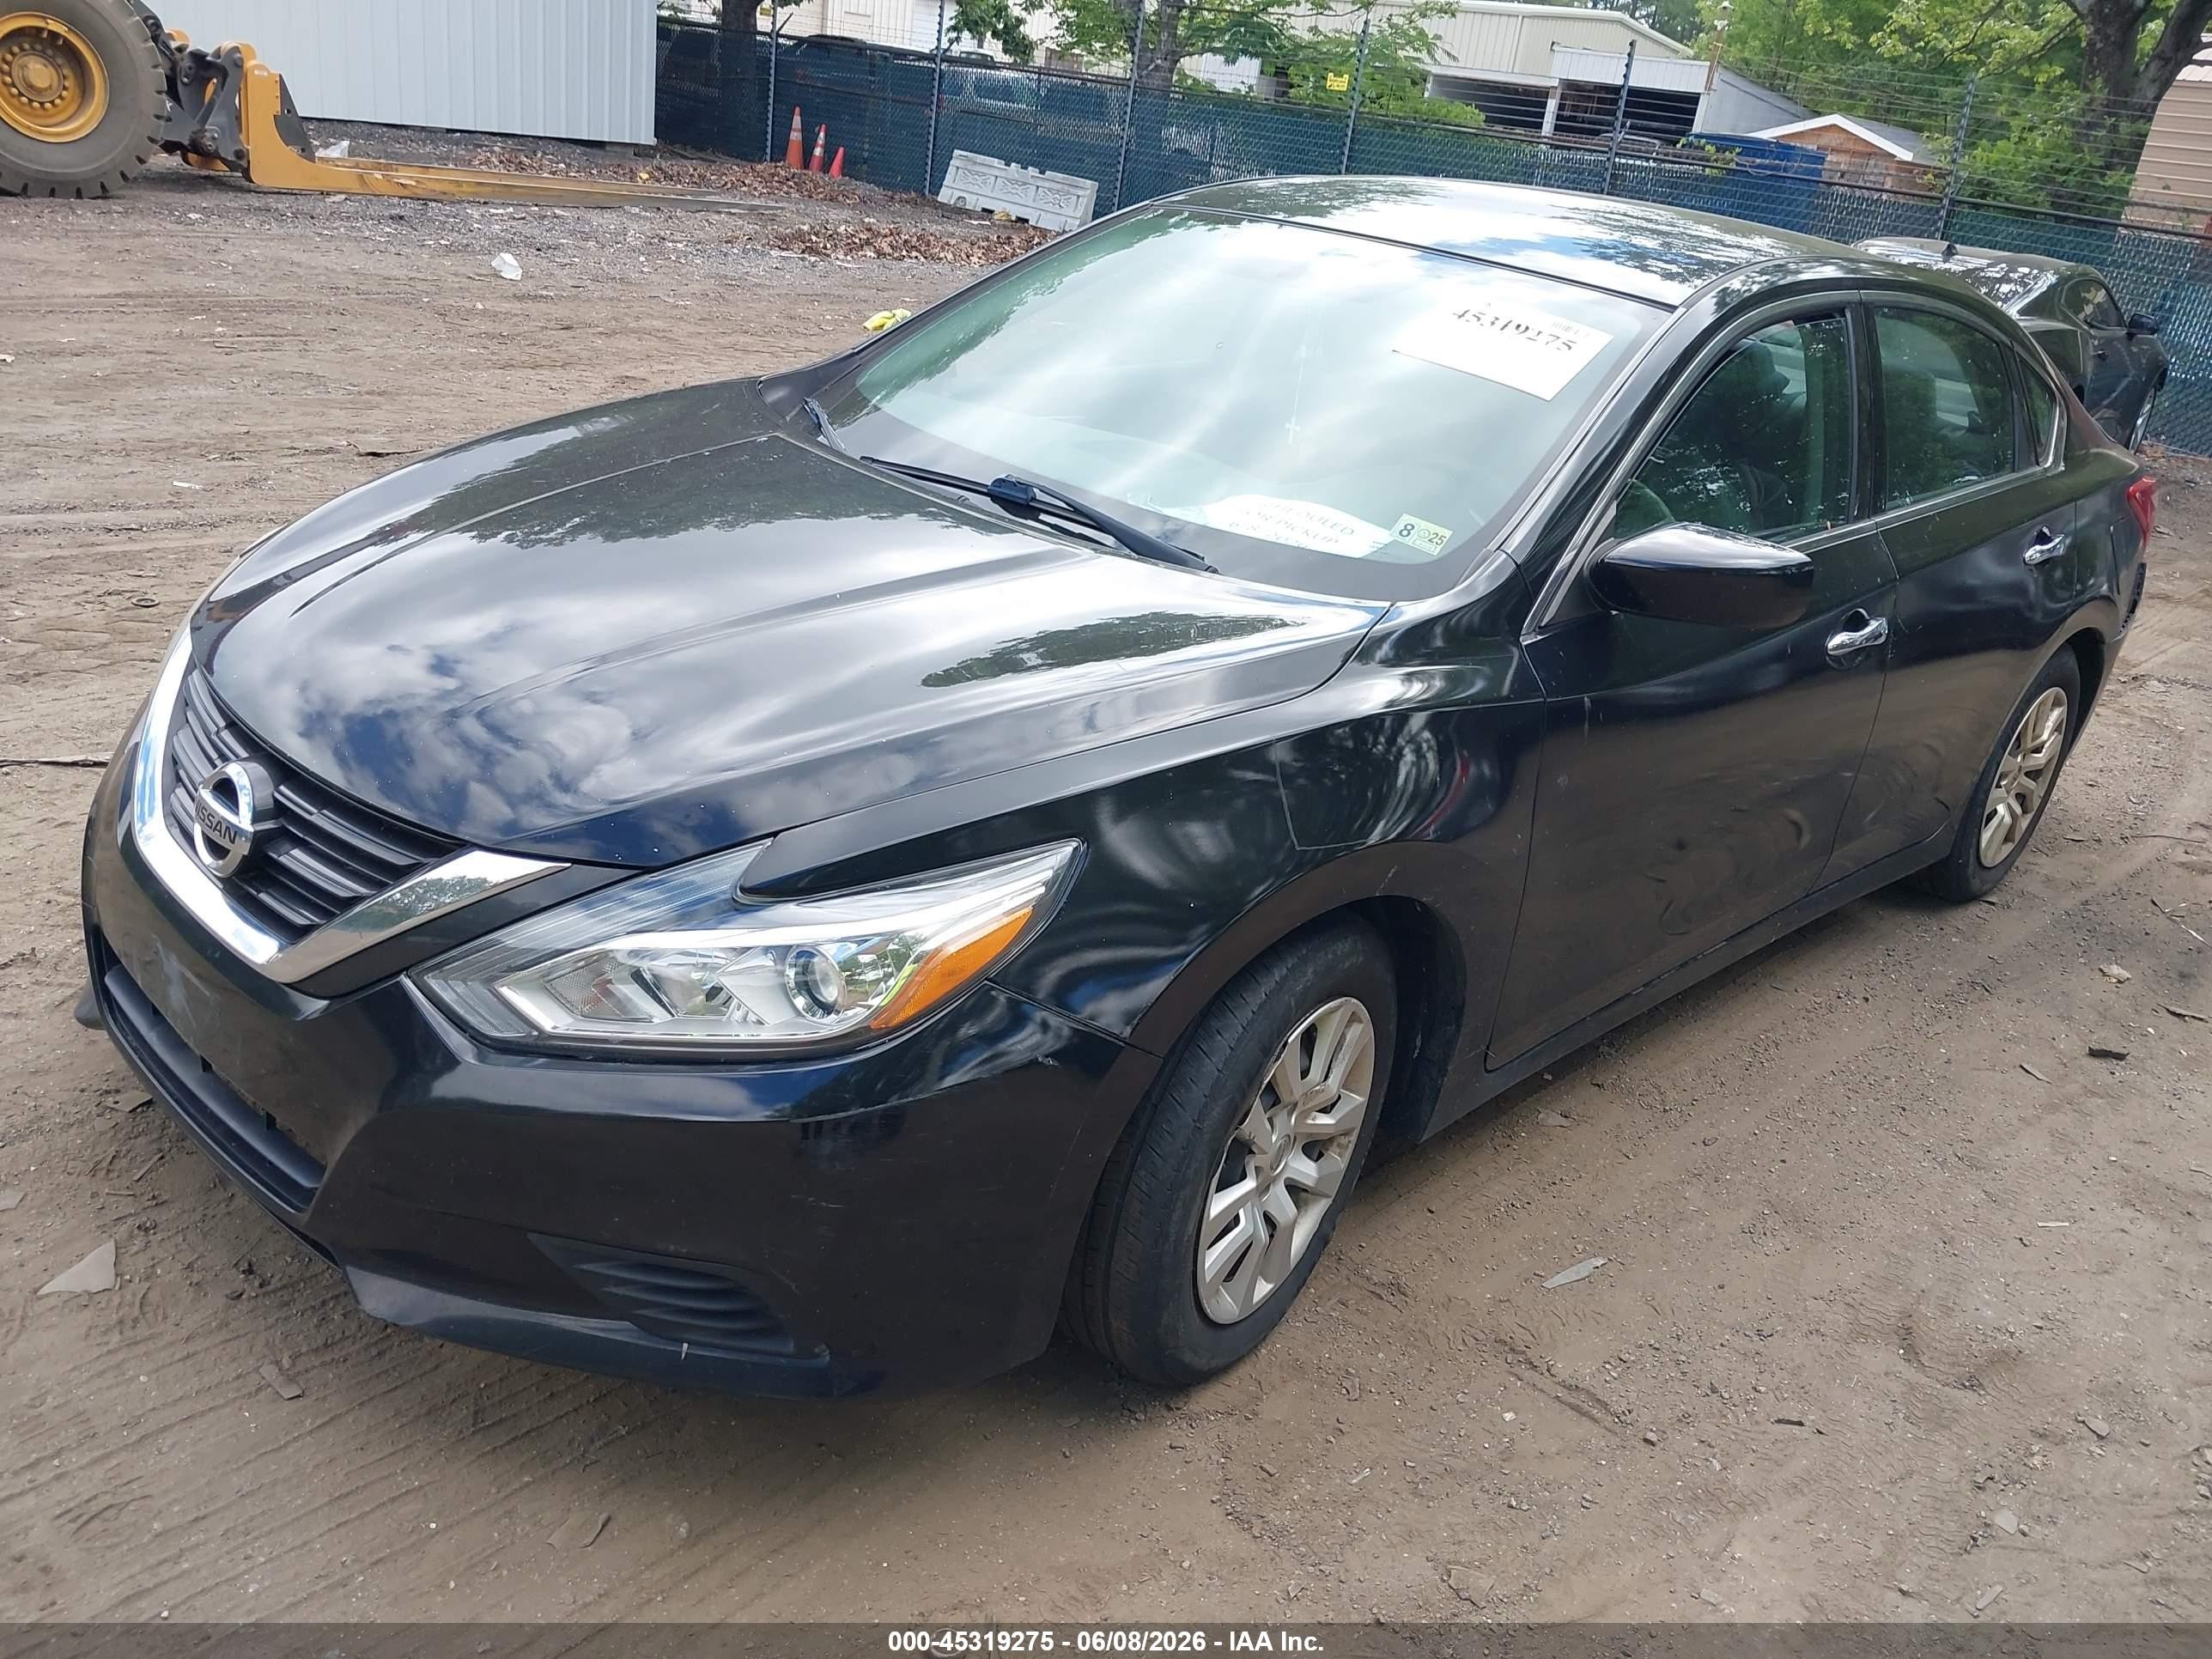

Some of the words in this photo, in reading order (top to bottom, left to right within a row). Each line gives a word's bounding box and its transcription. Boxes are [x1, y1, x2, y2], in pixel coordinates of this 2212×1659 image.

[1452, 308, 1578, 352] 45319275
[1398, 523, 1415, 538] 8
[1427, 532, 1447, 546] 25
